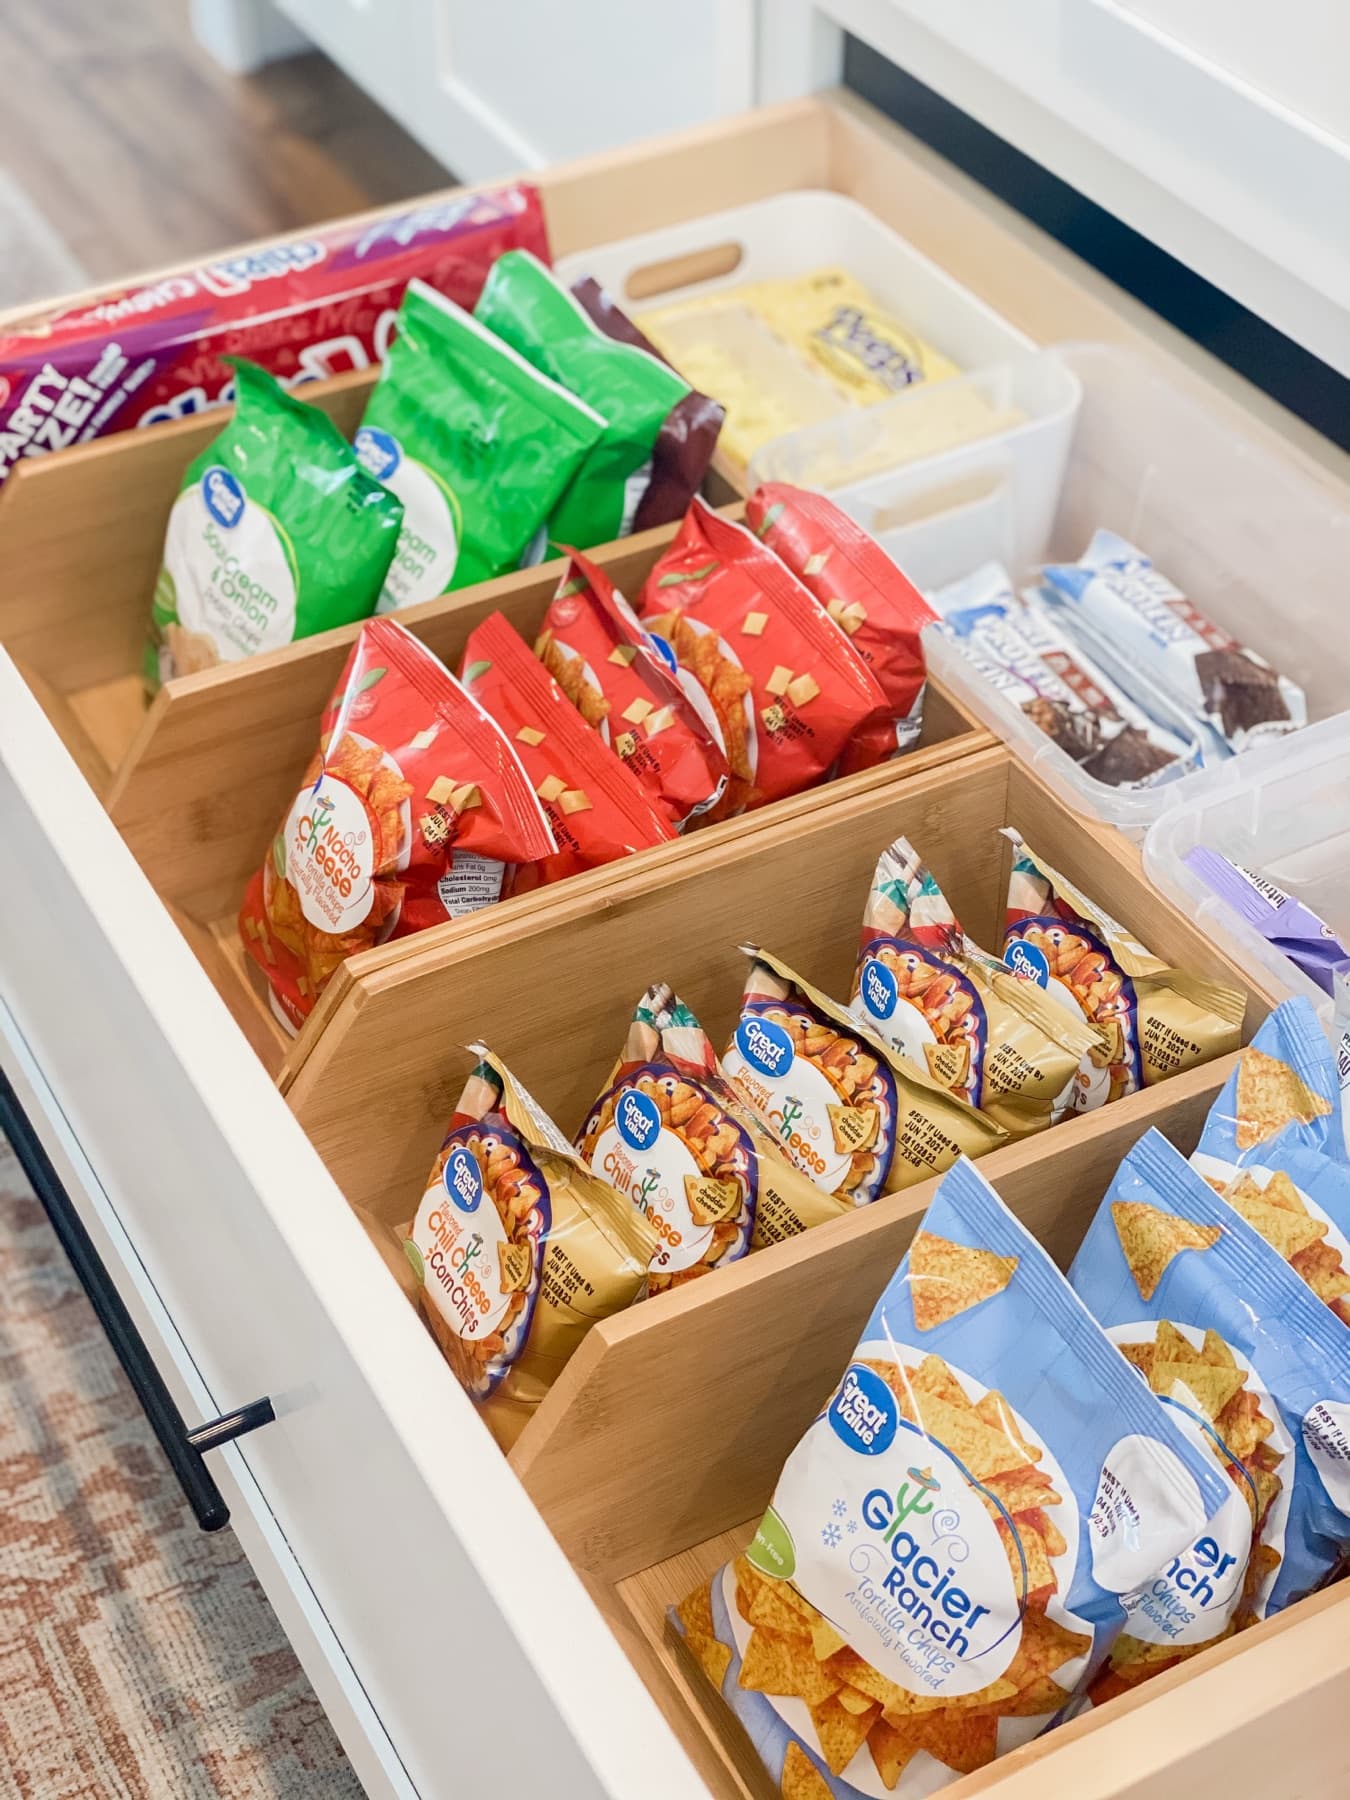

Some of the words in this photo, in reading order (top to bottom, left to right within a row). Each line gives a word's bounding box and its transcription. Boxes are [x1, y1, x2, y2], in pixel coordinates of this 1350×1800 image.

[23, 376, 104, 457] IZE!
[398, 548, 425, 580] ion
[400, 527, 437, 564] eam
[223, 556, 279, 613] Cream
[220, 579, 269, 631] Onion
[430, 815, 443, 828] JUL
[298, 807, 352, 898] Cheese
[322, 825, 361, 880] Nacho
[1012, 946, 1043, 983] Great
[867, 966, 891, 1005] Great
[868, 984, 886, 1012] Value
[745, 1022, 786, 1063] Great
[748, 1038, 777, 1071] Value
[1144, 1028, 1161, 1043] JUN
[1160, 1037, 1167, 1045] 7
[1166, 1041, 1185, 1057] 2021
[1144, 1040, 1180, 1066] 08102823
[1146, 1016, 1166, 1032] BEST
[1170, 1031, 1190, 1049] Used
[1190, 1043, 1202, 1055] By
[993, 1052, 1008, 1067] JUN
[1005, 1060, 1014, 1069] 7
[1010, 1065, 1028, 1082] 2021
[998, 1043, 1017, 1058] BEST
[1034, 1068, 1046, 1081] By
[738, 1066, 775, 1099] Flavored
[624, 1096, 653, 1135] Great
[625, 1115, 646, 1143] Value
[908, 1109, 929, 1127] BEST
[933, 1128, 953, 1147] Used
[950, 1143, 962, 1157] By
[900, 1132, 937, 1165] 08102823
[904, 1120, 922, 1136] JUN
[920, 1132, 928, 1140] 7
[925, 1137, 945, 1154] 2021
[453, 1154, 479, 1197] Great
[453, 1173, 473, 1206] Value
[604, 1153, 631, 1192] Chili
[631, 1177, 683, 1247] Cheese
[696, 1197, 719, 1216] cheese
[761, 1201, 778, 1217] JUN
[775, 1214, 783, 1222] 7
[766, 1188, 786, 1209] BEST
[788, 1212, 808, 1233] Used
[757, 1212, 786, 1243] 0810282
[428, 1211, 456, 1254] Chili
[451, 1241, 491, 1314] Cheese
[547, 1258, 562, 1274] JUN
[558, 1270, 566, 1279] 7
[562, 1275, 579, 1295] 2021
[551, 1245, 569, 1264] BEST
[569, 1266, 586, 1286] Used
[584, 1282, 595, 1297] By
[430, 1252, 455, 1293] Corn
[451, 1287, 479, 1336] Chips
[837, 1396, 874, 1445] Value
[843, 1372, 888, 1434] Great
[1314, 1404, 1337, 1428] BEST
[1101, 1481, 1114, 1500] JUL
[1102, 1466, 1121, 1489] BEST
[862, 1482, 991, 1631] Glacier
[1151, 1579, 1196, 1624] Chips
[1166, 1557, 1214, 1608] nch
[857, 1575, 905, 1635] Tortilla
[907, 1627, 956, 1674] Chips
[882, 1565, 970, 1658] Ranch
[1139, 1593, 1185, 1639] Flavored
[845, 1590, 893, 1649] Artificially
[893, 1640, 945, 1690] Flavored
